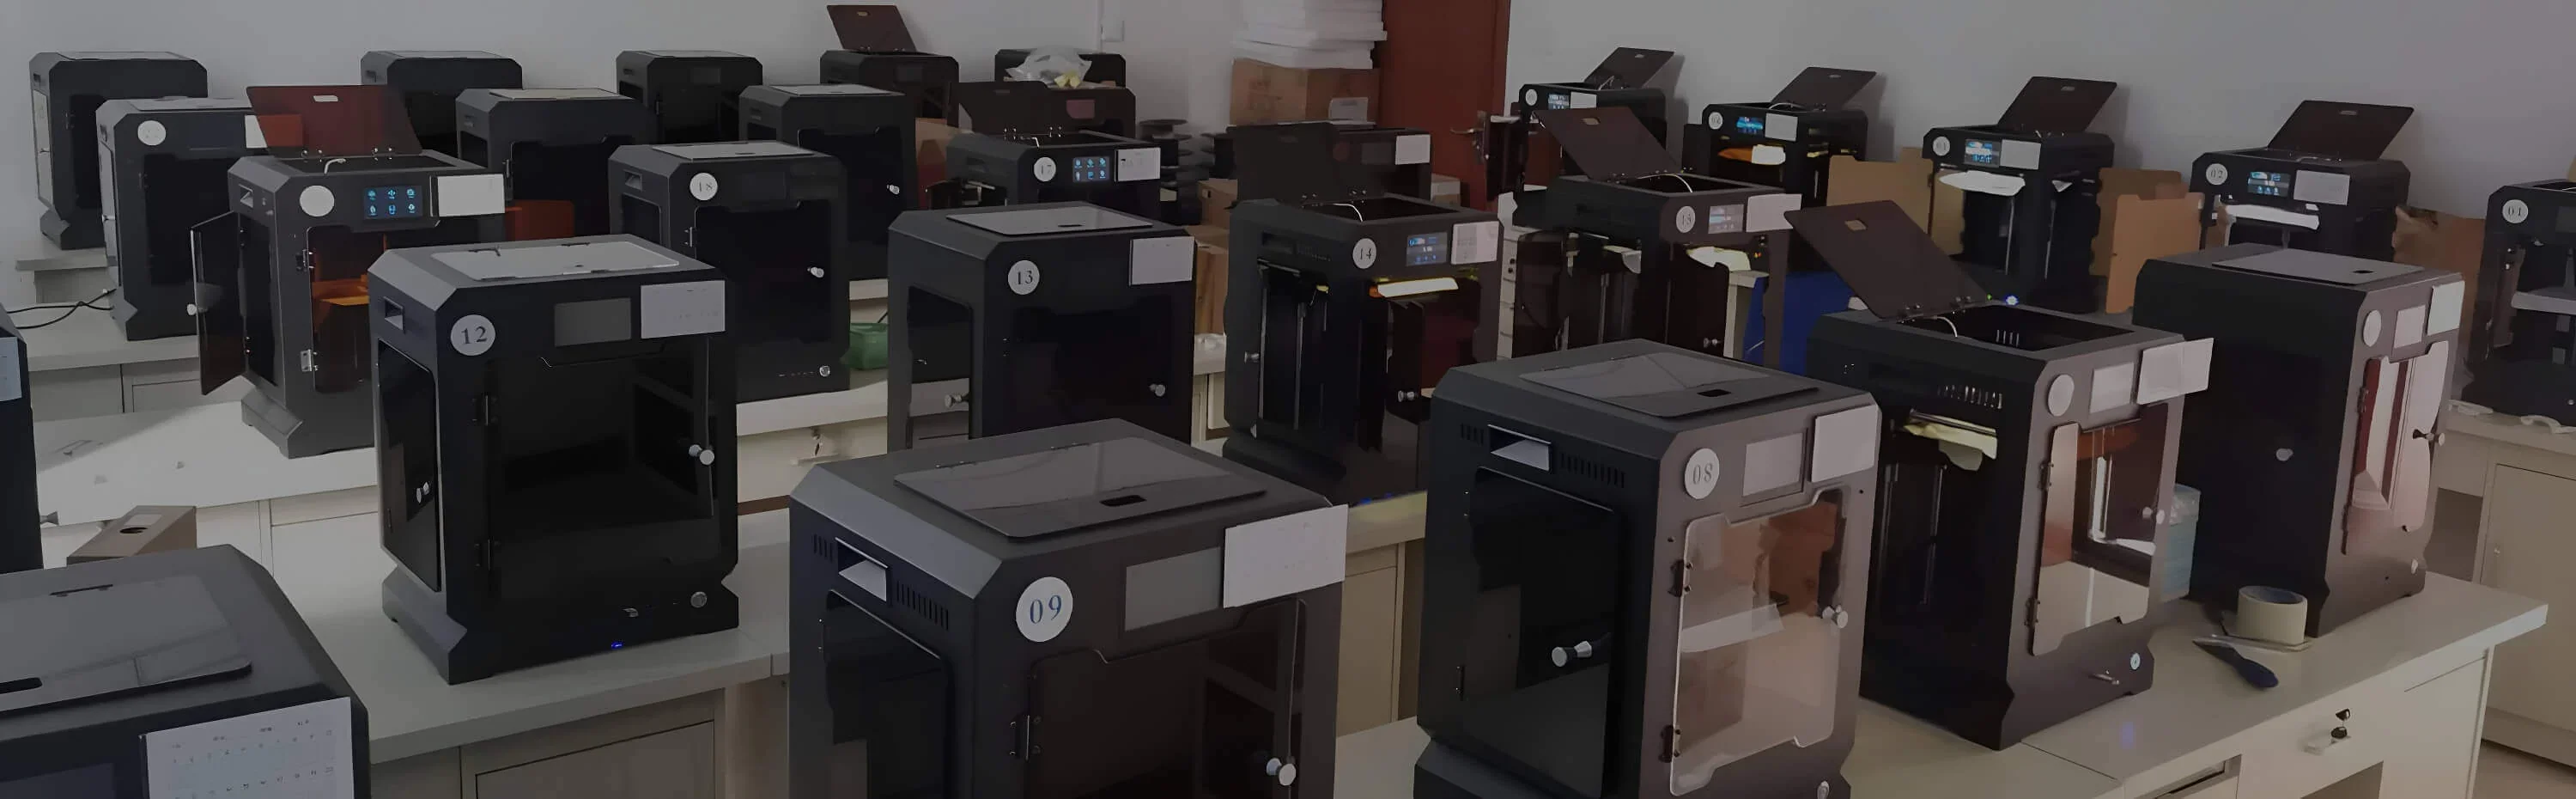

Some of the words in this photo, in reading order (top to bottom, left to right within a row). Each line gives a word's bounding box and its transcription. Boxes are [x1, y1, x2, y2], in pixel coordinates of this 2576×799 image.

[2507, 205, 2523, 217] 01
[1359, 247, 1373, 260] 14
[1017, 270, 1034, 285] 13
[460, 326, 489, 345] 12
[1692, 462, 1714, 485] 08
[1030, 594, 1063, 625] 09
